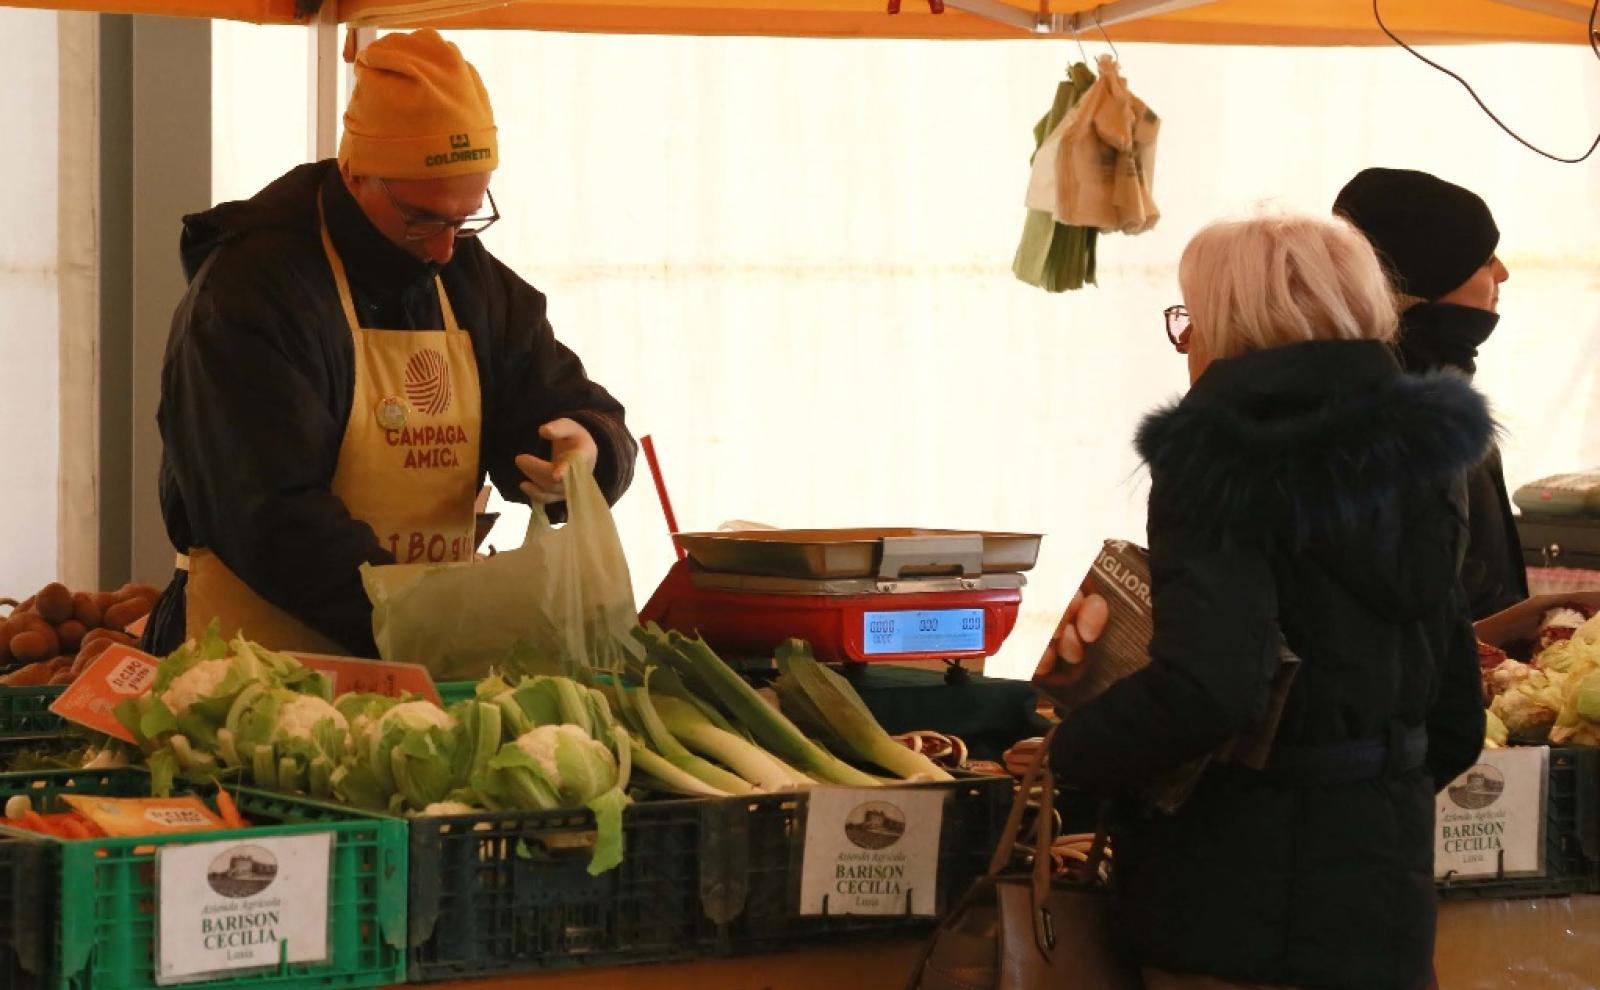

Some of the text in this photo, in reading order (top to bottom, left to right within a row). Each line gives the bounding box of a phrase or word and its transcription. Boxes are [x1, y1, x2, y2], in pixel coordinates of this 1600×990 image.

[426, 147, 491, 167] COLDIRETTI
[385, 425, 468, 447] CAMPAGA
[403, 447, 460, 469] AMICA
[387, 532, 447, 564] IBO
[1442, 821, 1505, 840] BARISON
[1444, 837, 1502, 853] CECILIA
[835, 863, 904, 880] BARISON
[836, 879, 901, 895] CECILIA
[202, 911, 280, 935] BARISON
[204, 929, 277, 951] CECILIA
